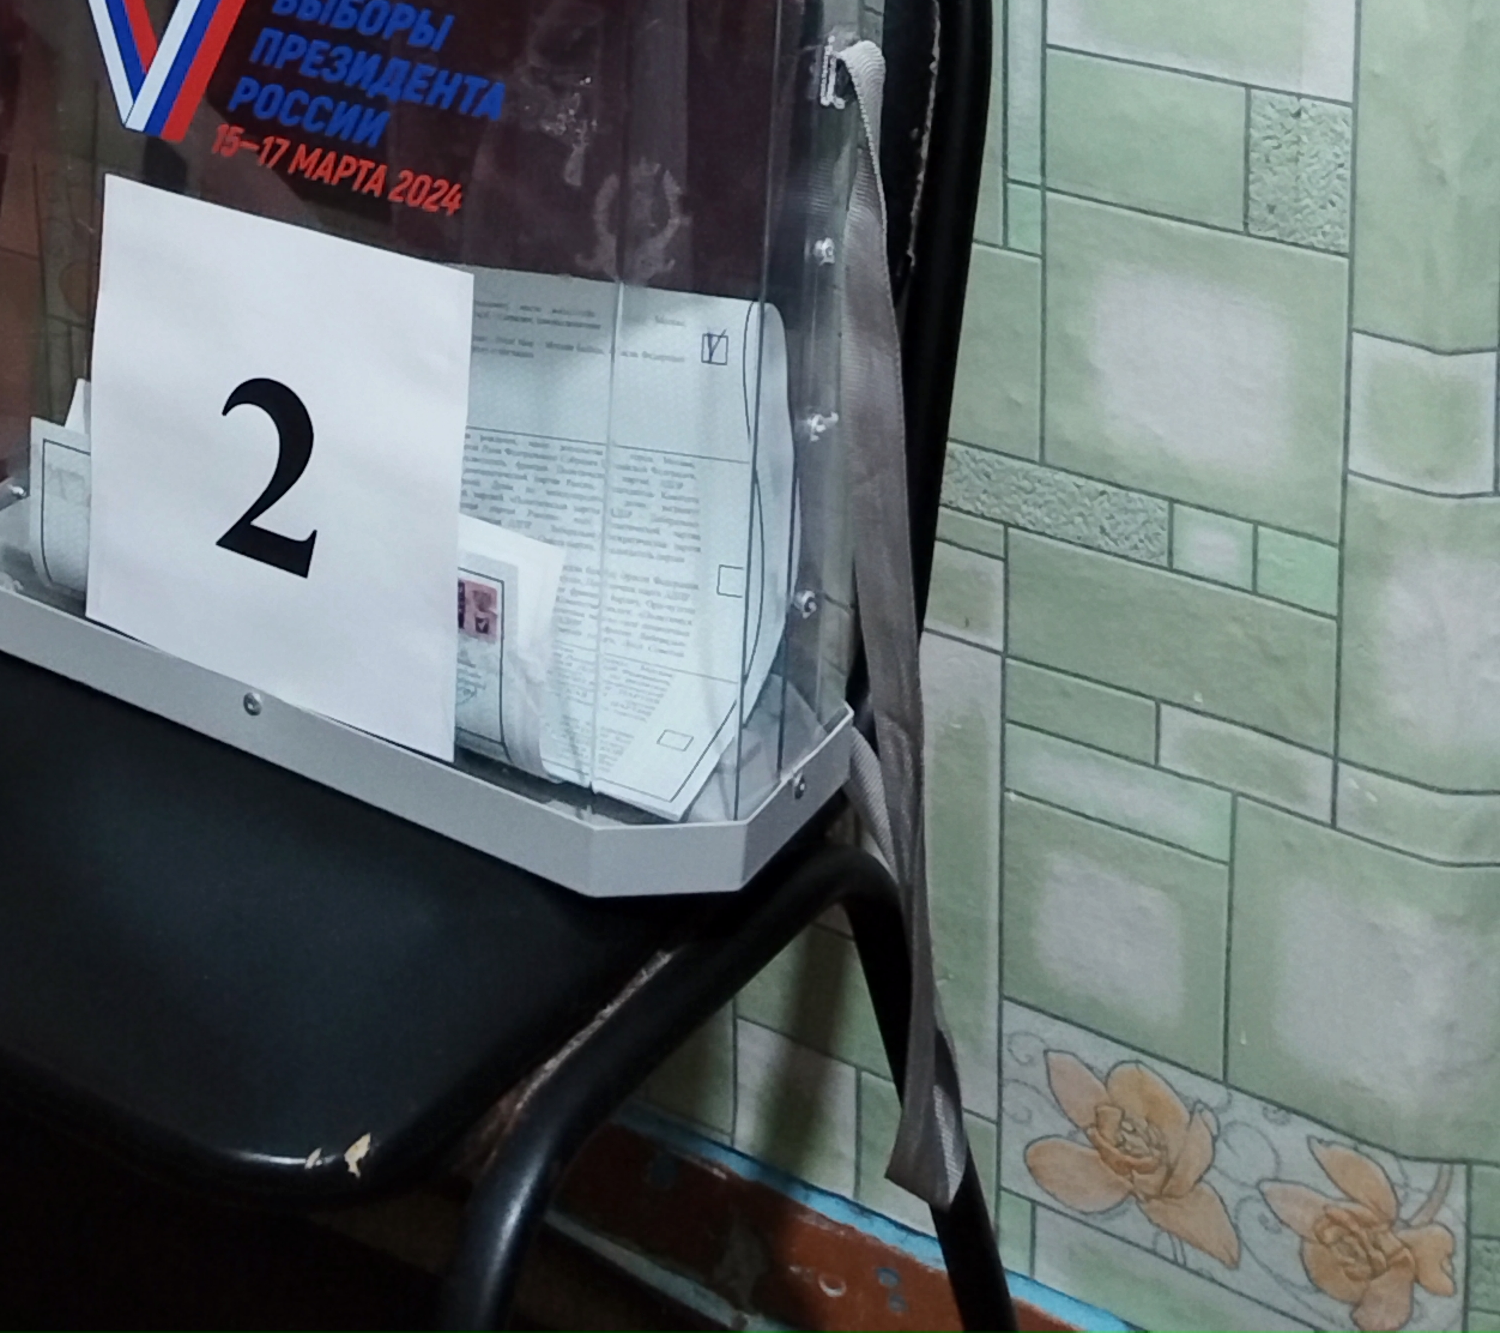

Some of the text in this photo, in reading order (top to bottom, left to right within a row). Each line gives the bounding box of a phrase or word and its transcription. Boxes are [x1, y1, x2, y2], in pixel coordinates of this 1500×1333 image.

[227, 76, 391, 149] РОССИИ
[249, 27, 508, 122] ПРЕЗИДЕНТА
[289, 143, 389, 199] МАРТА
[387, 169, 464, 217] 2024
[214, 377, 318, 579] 2
